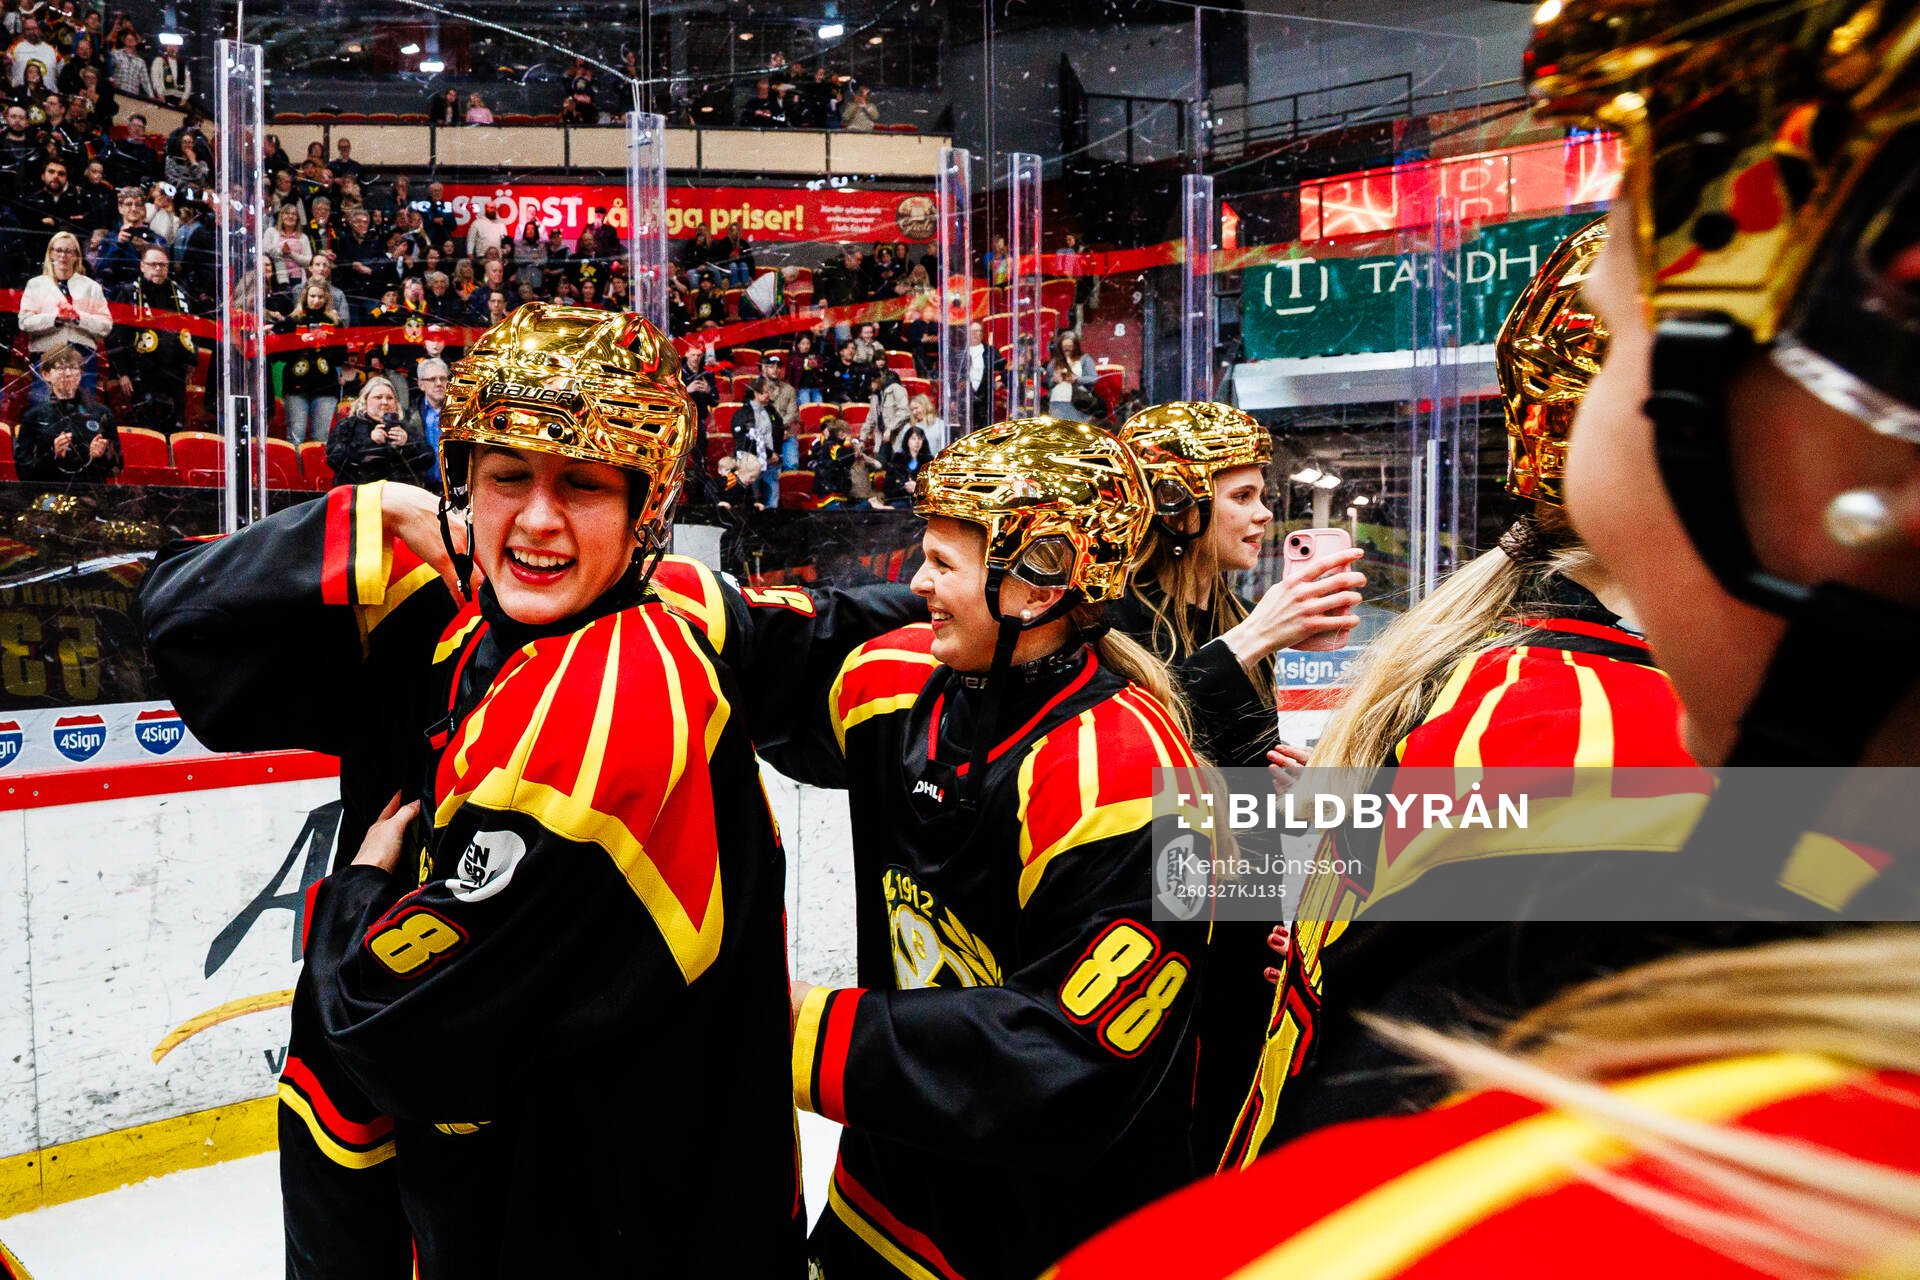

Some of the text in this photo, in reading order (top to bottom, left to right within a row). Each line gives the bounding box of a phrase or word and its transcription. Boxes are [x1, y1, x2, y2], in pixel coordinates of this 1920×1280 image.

[711, 202, 804, 235] priser!
[1358, 236, 1568, 293] TANDH
[488, 382, 577, 405] BAUER
[1275, 656, 1359, 683] 4sign.s
[60, 732, 100, 751] 4Sign
[141, 725, 179, 745] 4Sign
[895, 873, 934, 919] 1912
[1060, 924, 1189, 1053] 88
